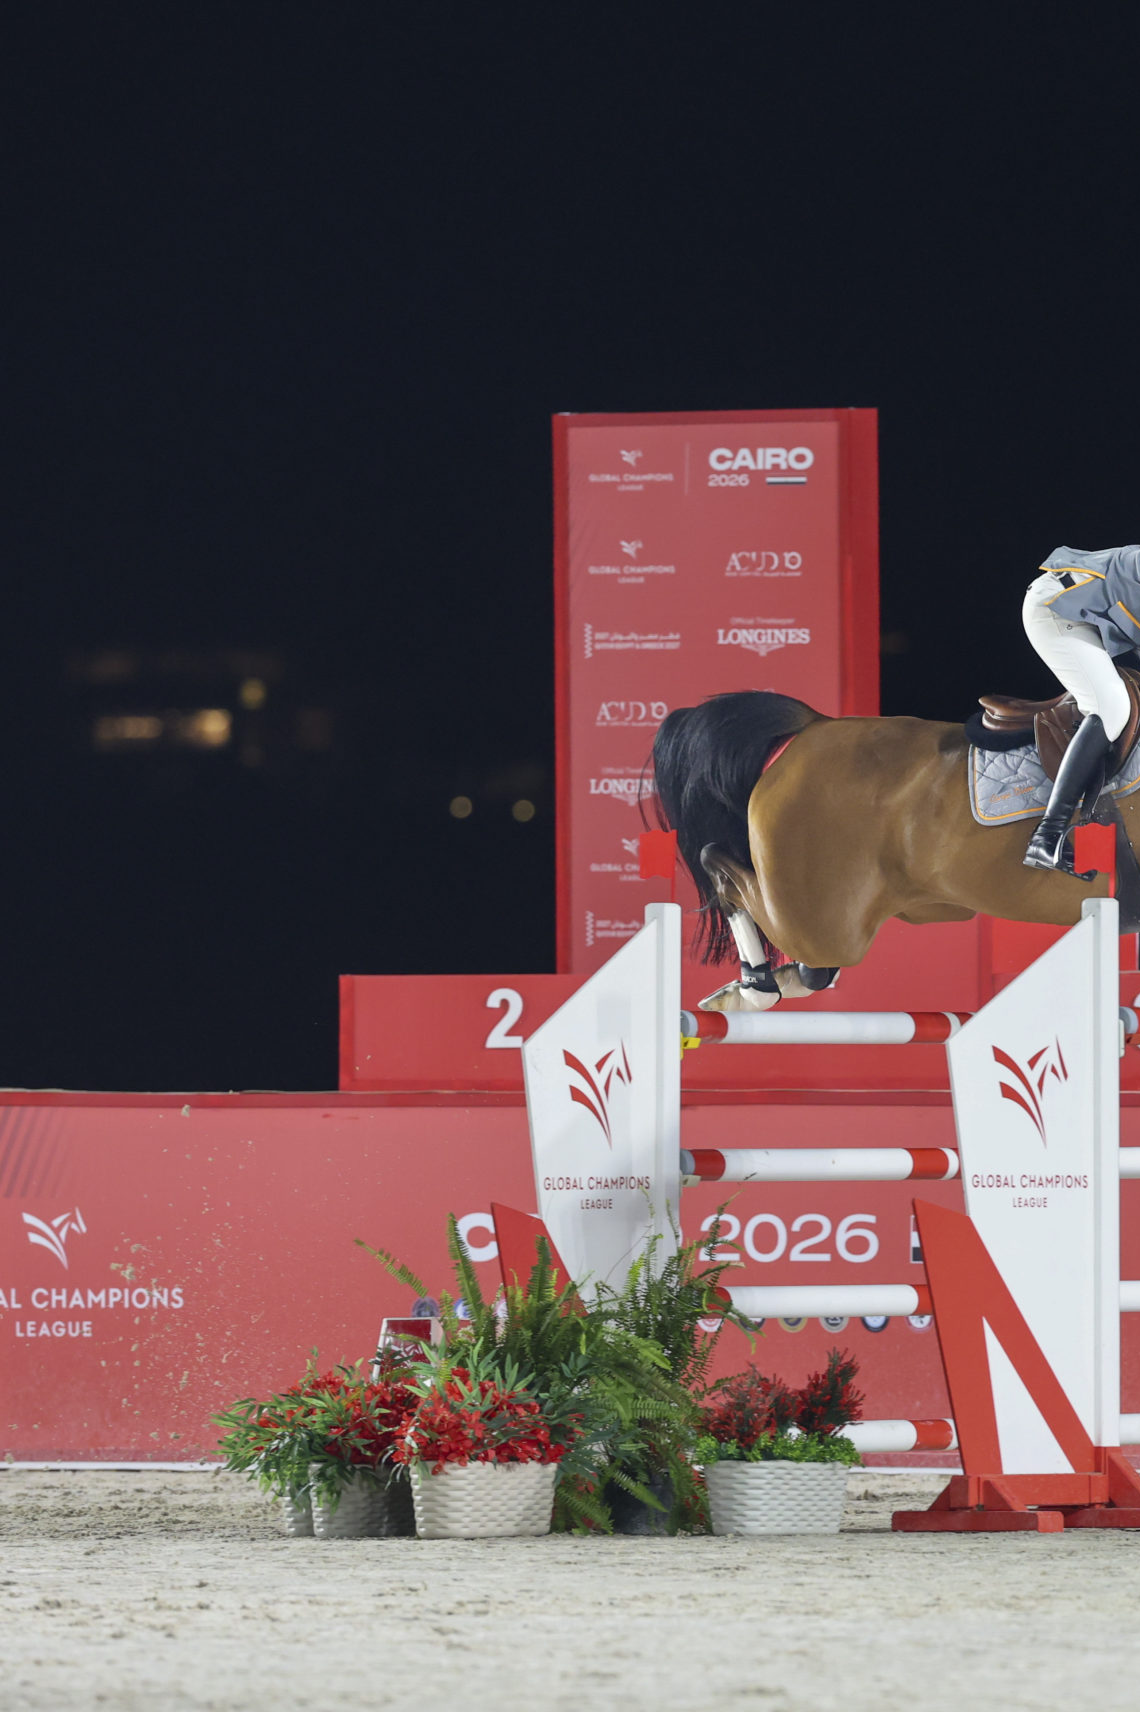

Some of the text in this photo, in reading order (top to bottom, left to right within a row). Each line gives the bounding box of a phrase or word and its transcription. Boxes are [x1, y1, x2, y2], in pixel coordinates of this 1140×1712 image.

[709, 447, 814, 471] CAIRO
[708, 473, 750, 487] 2026
[717, 628, 810, 645] LONGINES
[485, 988, 523, 1048] 2
[543, 1175, 651, 1191] GLOBAL CHAMPIONS
[971, 1174, 1089, 1189] GLOBAL CHAMPIONS
[580, 1198, 614, 1210] LEAGUE
[1012, 1196, 1048, 1209] LEAGUE
[698, 1212, 879, 1264] 2026
[30, 1287, 185, 1309] CHAMPIONS
[15, 1320, 93, 1337] LEAGUE
